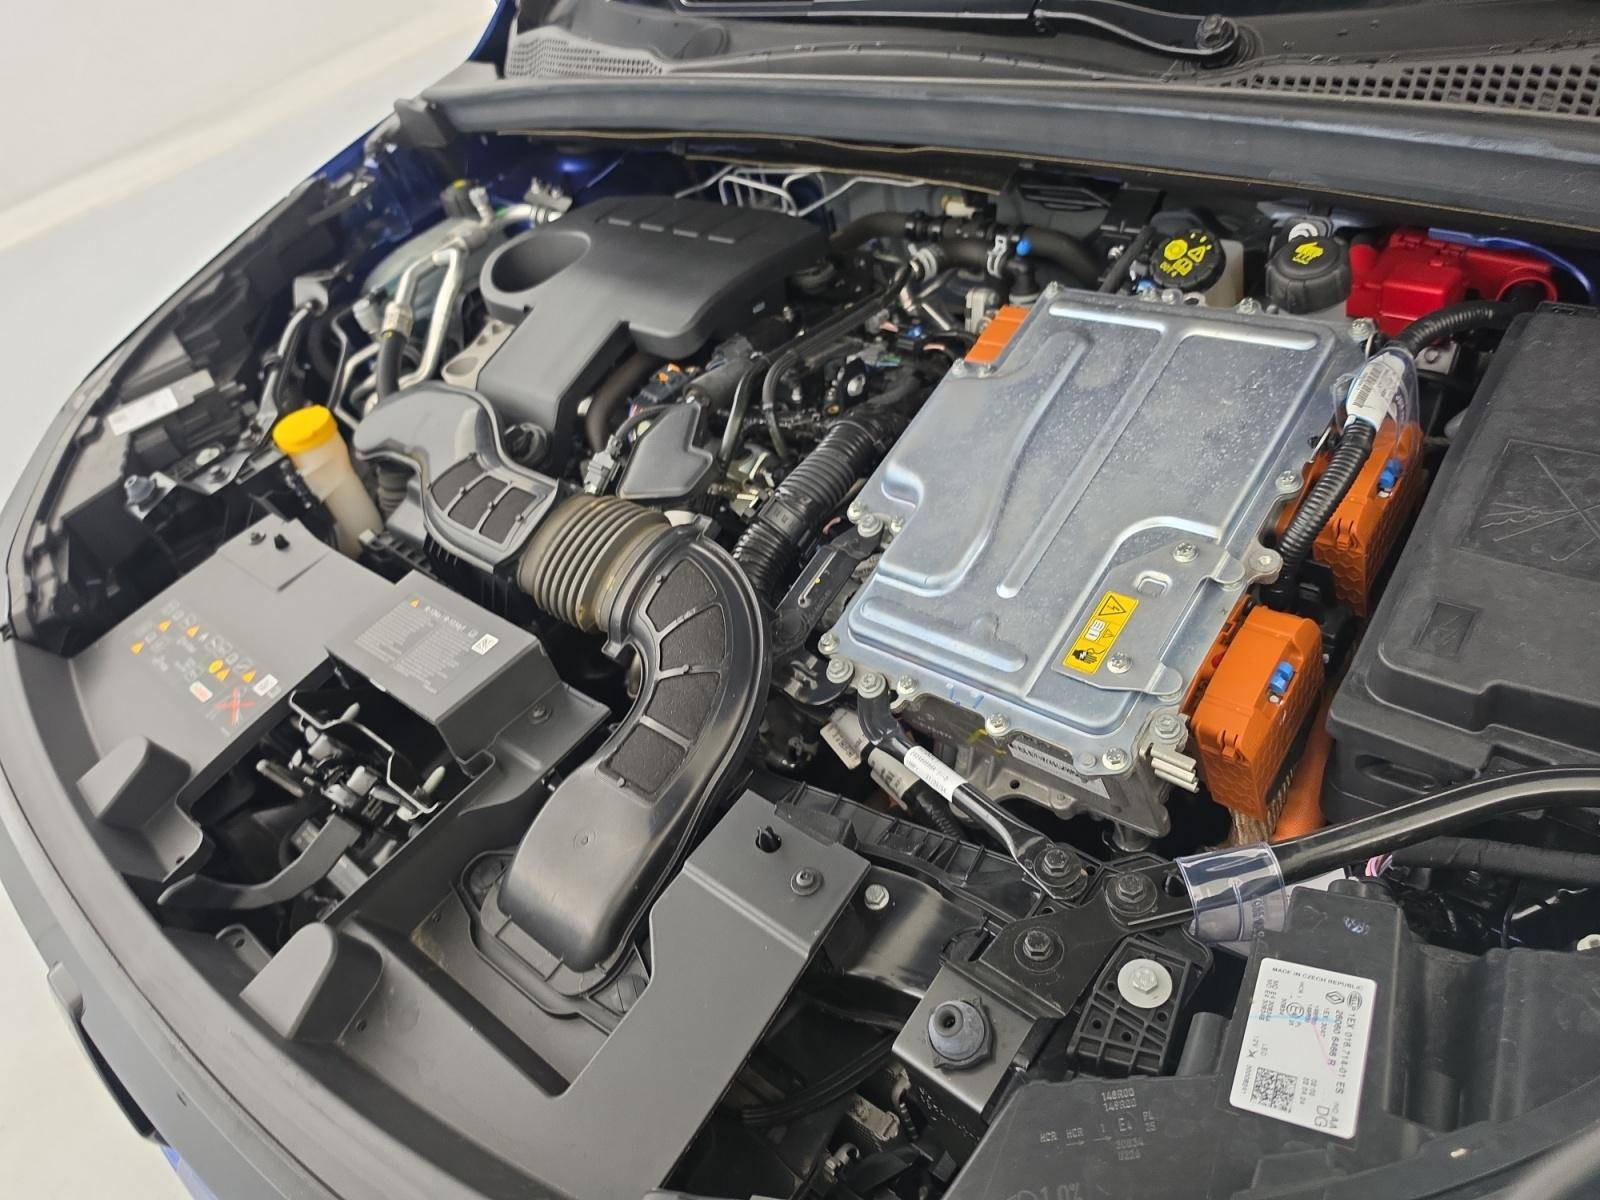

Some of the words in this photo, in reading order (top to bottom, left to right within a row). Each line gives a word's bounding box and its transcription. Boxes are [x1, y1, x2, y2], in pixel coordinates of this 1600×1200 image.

[1272, 967, 1291, 975] MADE
[1302, 973, 1327, 984] CZECH
[1346, 1012, 1355, 1029] 1EX
[1335, 1081, 1344, 1095] ES
[1313, 1104, 1329, 1129] DG
